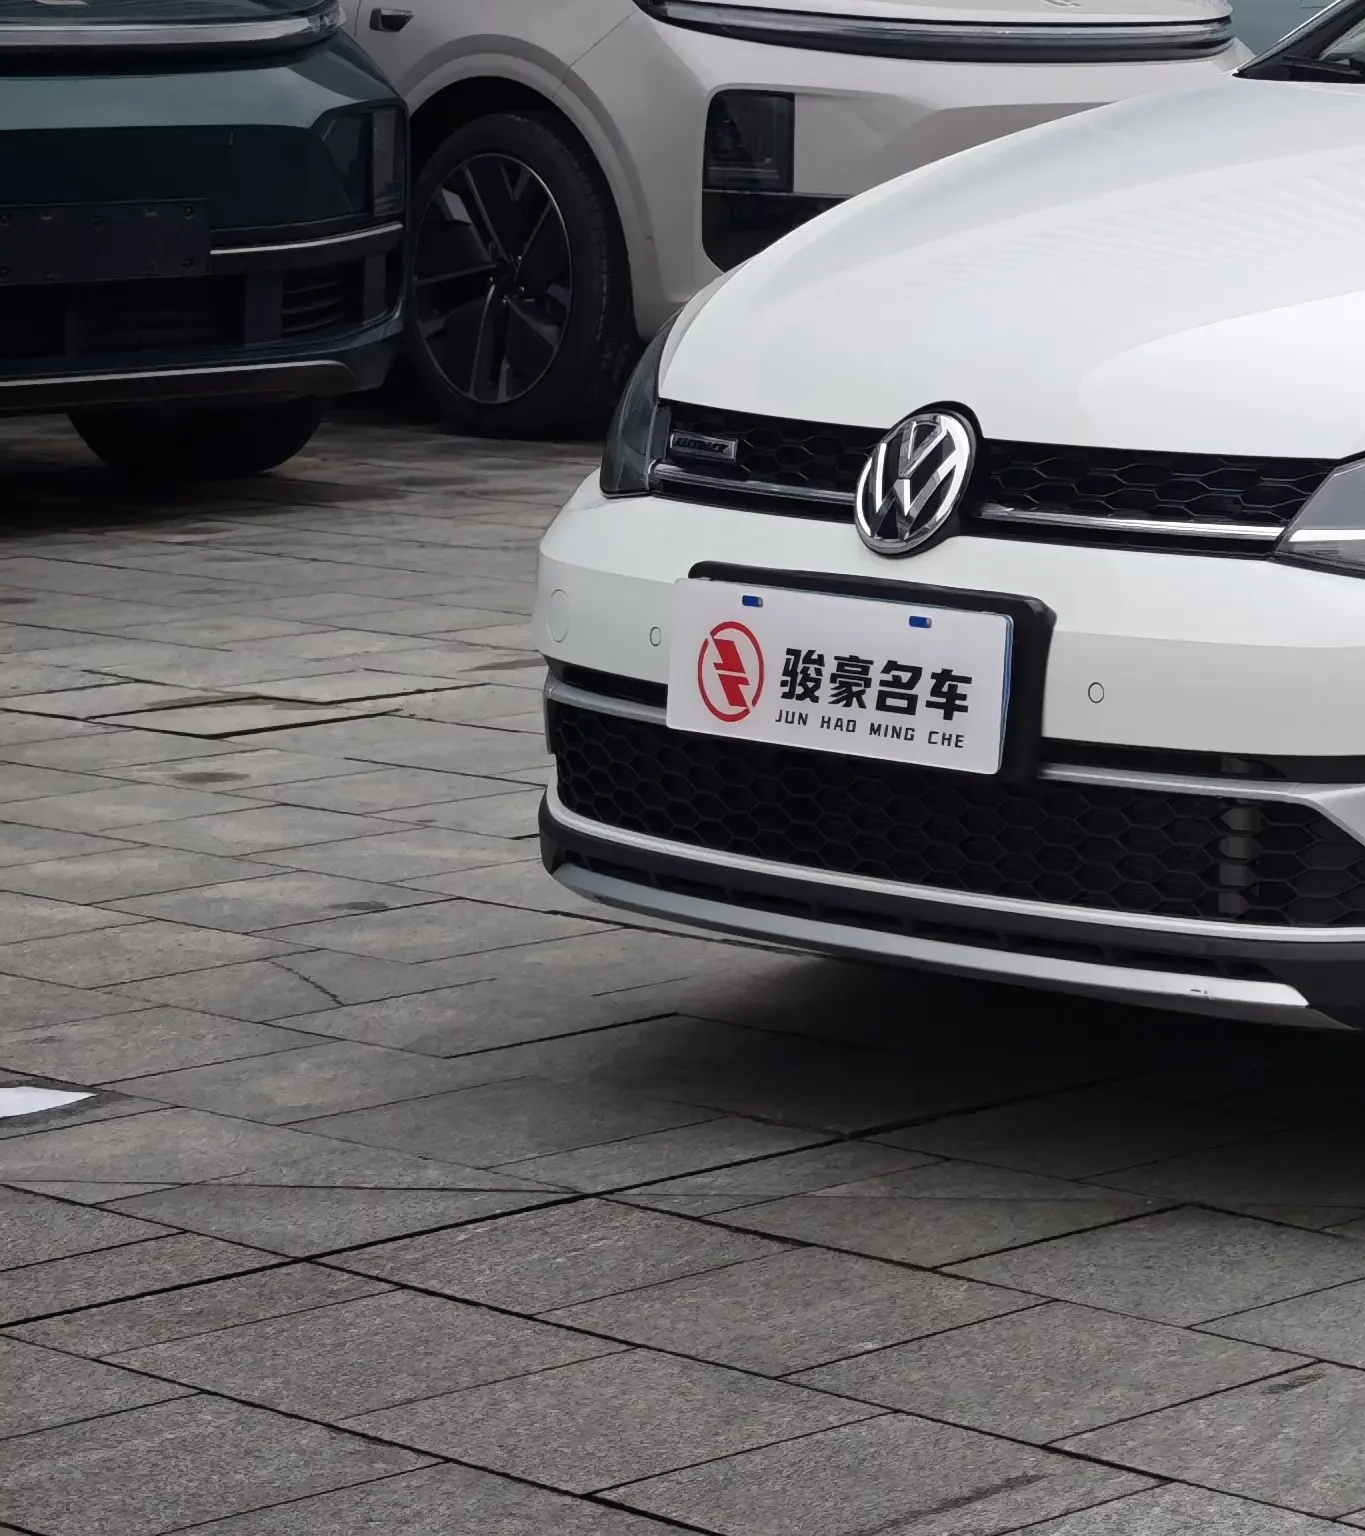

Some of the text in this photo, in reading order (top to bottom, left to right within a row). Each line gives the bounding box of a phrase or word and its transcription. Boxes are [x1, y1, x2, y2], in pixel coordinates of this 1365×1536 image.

[779, 647, 972, 721] 骏豪名车
[775, 709, 965, 749] JUN HAO MING CHE
